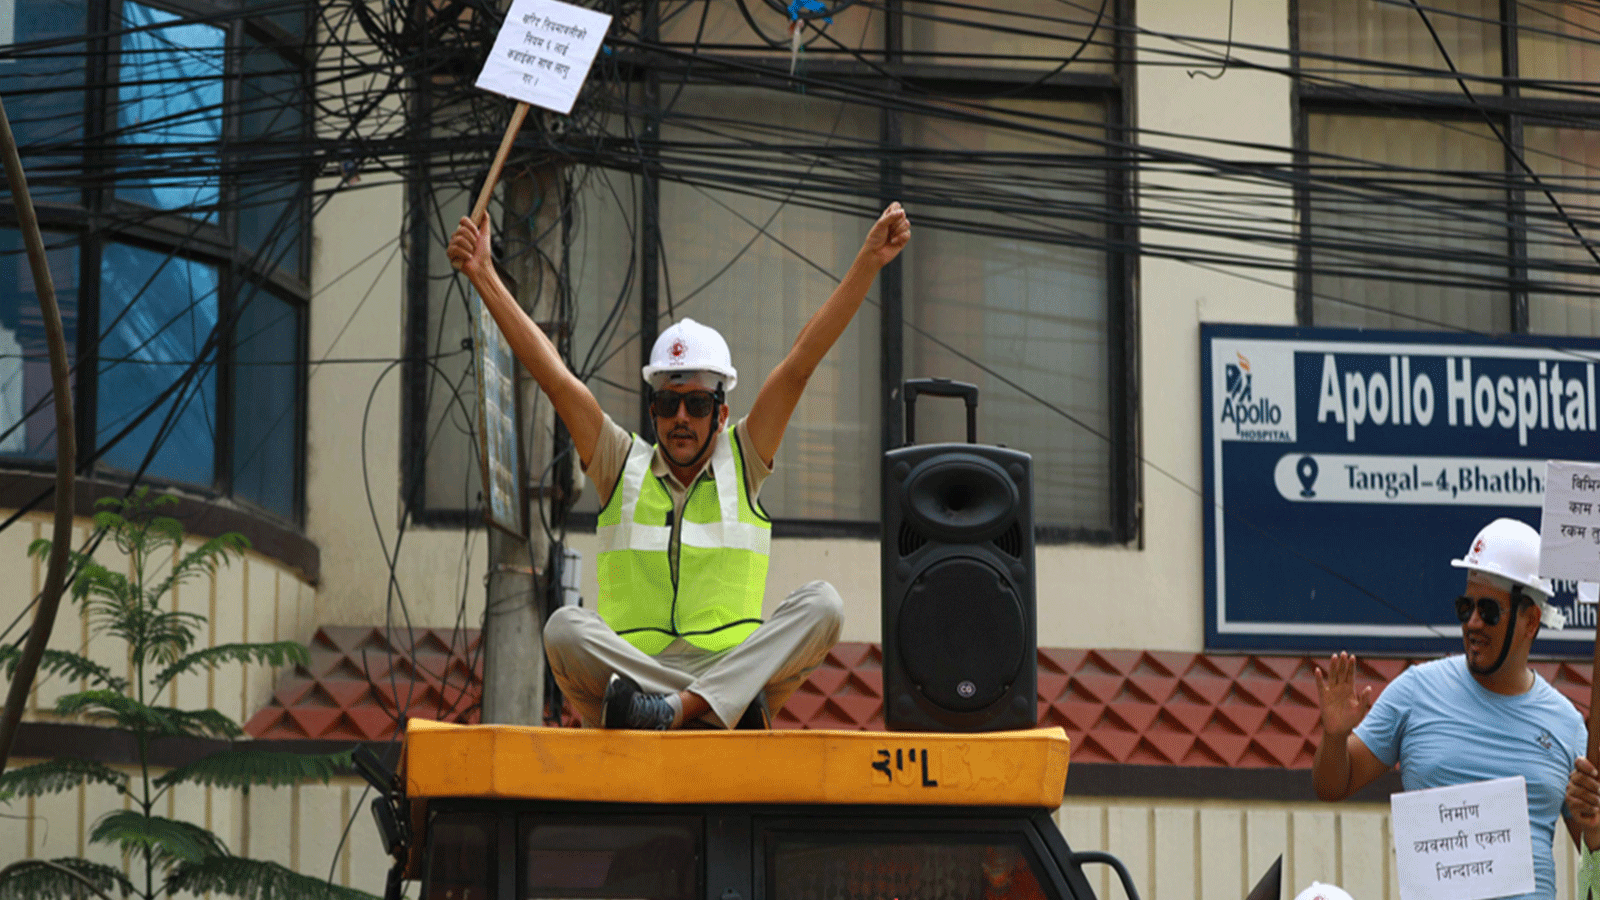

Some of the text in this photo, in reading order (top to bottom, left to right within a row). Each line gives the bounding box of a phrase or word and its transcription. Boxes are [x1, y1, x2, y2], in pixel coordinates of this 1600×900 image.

[523, 31, 545, 48] नियम
[554, 42, 570, 56] लाई
[537, 57, 554, 71] साथ
[1317, 353, 1598, 447] Apollo Hospital
[1221, 396, 1282, 435] Apollo
[1240, 429, 1291, 441] HOSPITAL
[1344, 464, 1545, 499] Tangal-4,Bhatbh
[1569, 500, 1593, 515] काम
[1561, 523, 1587, 539] रकम
[1438, 800, 1480, 824] निर्माण
[1413, 828, 1512, 855] व्यवसायी एकता
